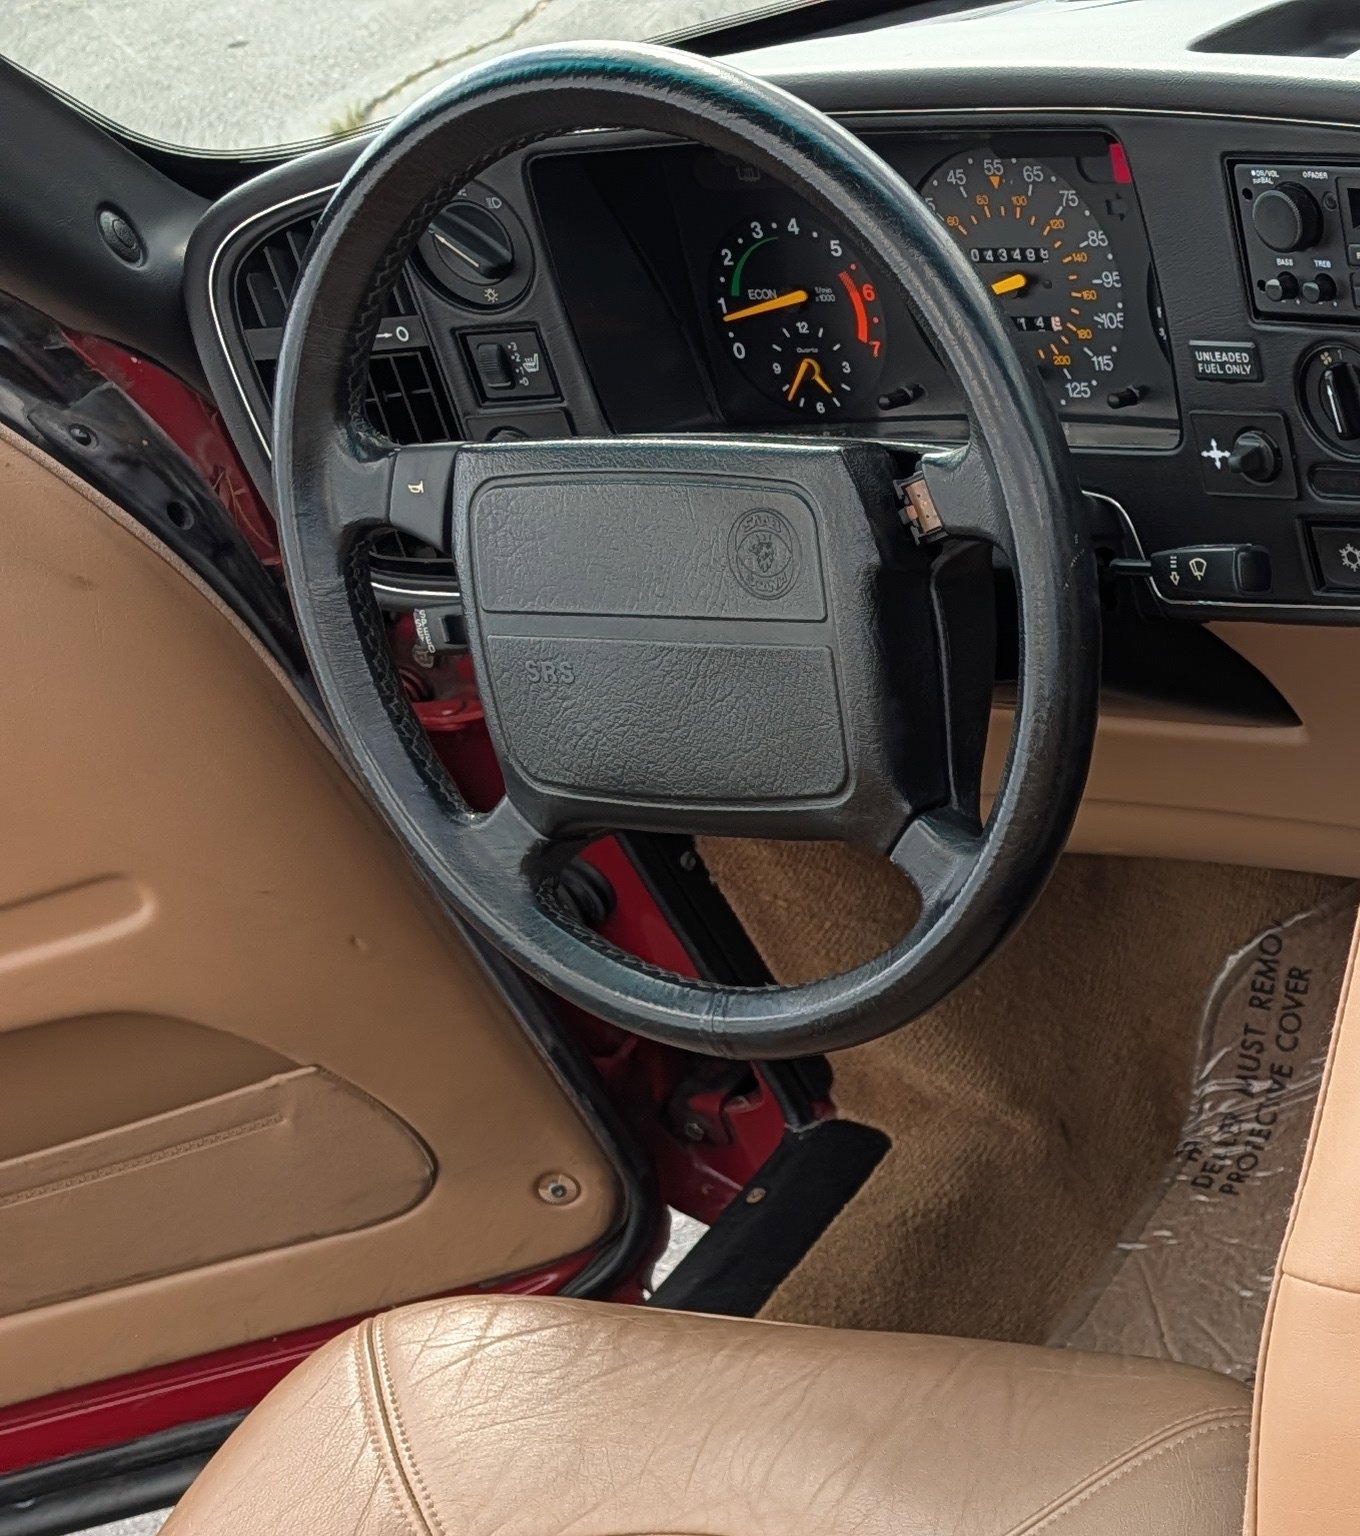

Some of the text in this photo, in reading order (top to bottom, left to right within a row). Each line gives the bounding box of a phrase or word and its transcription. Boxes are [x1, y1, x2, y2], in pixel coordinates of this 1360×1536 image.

[983, 159, 1004, 176] 55
[1022, 166, 1044, 182] 65
[947, 169, 967, 186] 45
[1011, 195, 1027, 206] 100
[1059, 190, 1079, 207] 75
[751, 222, 763, 238] 3
[787, 218, 800, 235] 4
[1050, 219, 1065, 229] 120
[1087, 230, 1109, 247] 85
[830, 240, 842, 256] 5
[721, 249, 734, 265] 2
[1072, 252, 1088, 263] 140
[1276, 258, 1293, 266] BASS
[1314, 260, 1332, 268] TREB
[1101, 271, 1122, 288] 95
[748, 289, 778, 300] ECON
[862, 284, 875, 300] 6
[718, 297, 728, 314] 1
[796, 321, 810, 334] 12
[1101, 312, 1124, 329] 105
[733, 342, 746, 359] 0
[870, 341, 881, 358] 7
[1195, 351, 1250, 363] UNLEADED
[773, 362, 782, 375] 9
[842, 361, 851, 374] 3
[1053, 355, 1071, 366] 200
[1091, 355, 1114, 372] 115
[1198, 362, 1252, 376] FUEL ONLY
[1065, 382, 1091, 399] 125
[816, 401, 826, 414] 6
[525, 660, 576, 684] SRS
[1250, 920, 1284, 1011] REMO
[1276, 966, 1312, 1053] COVER
